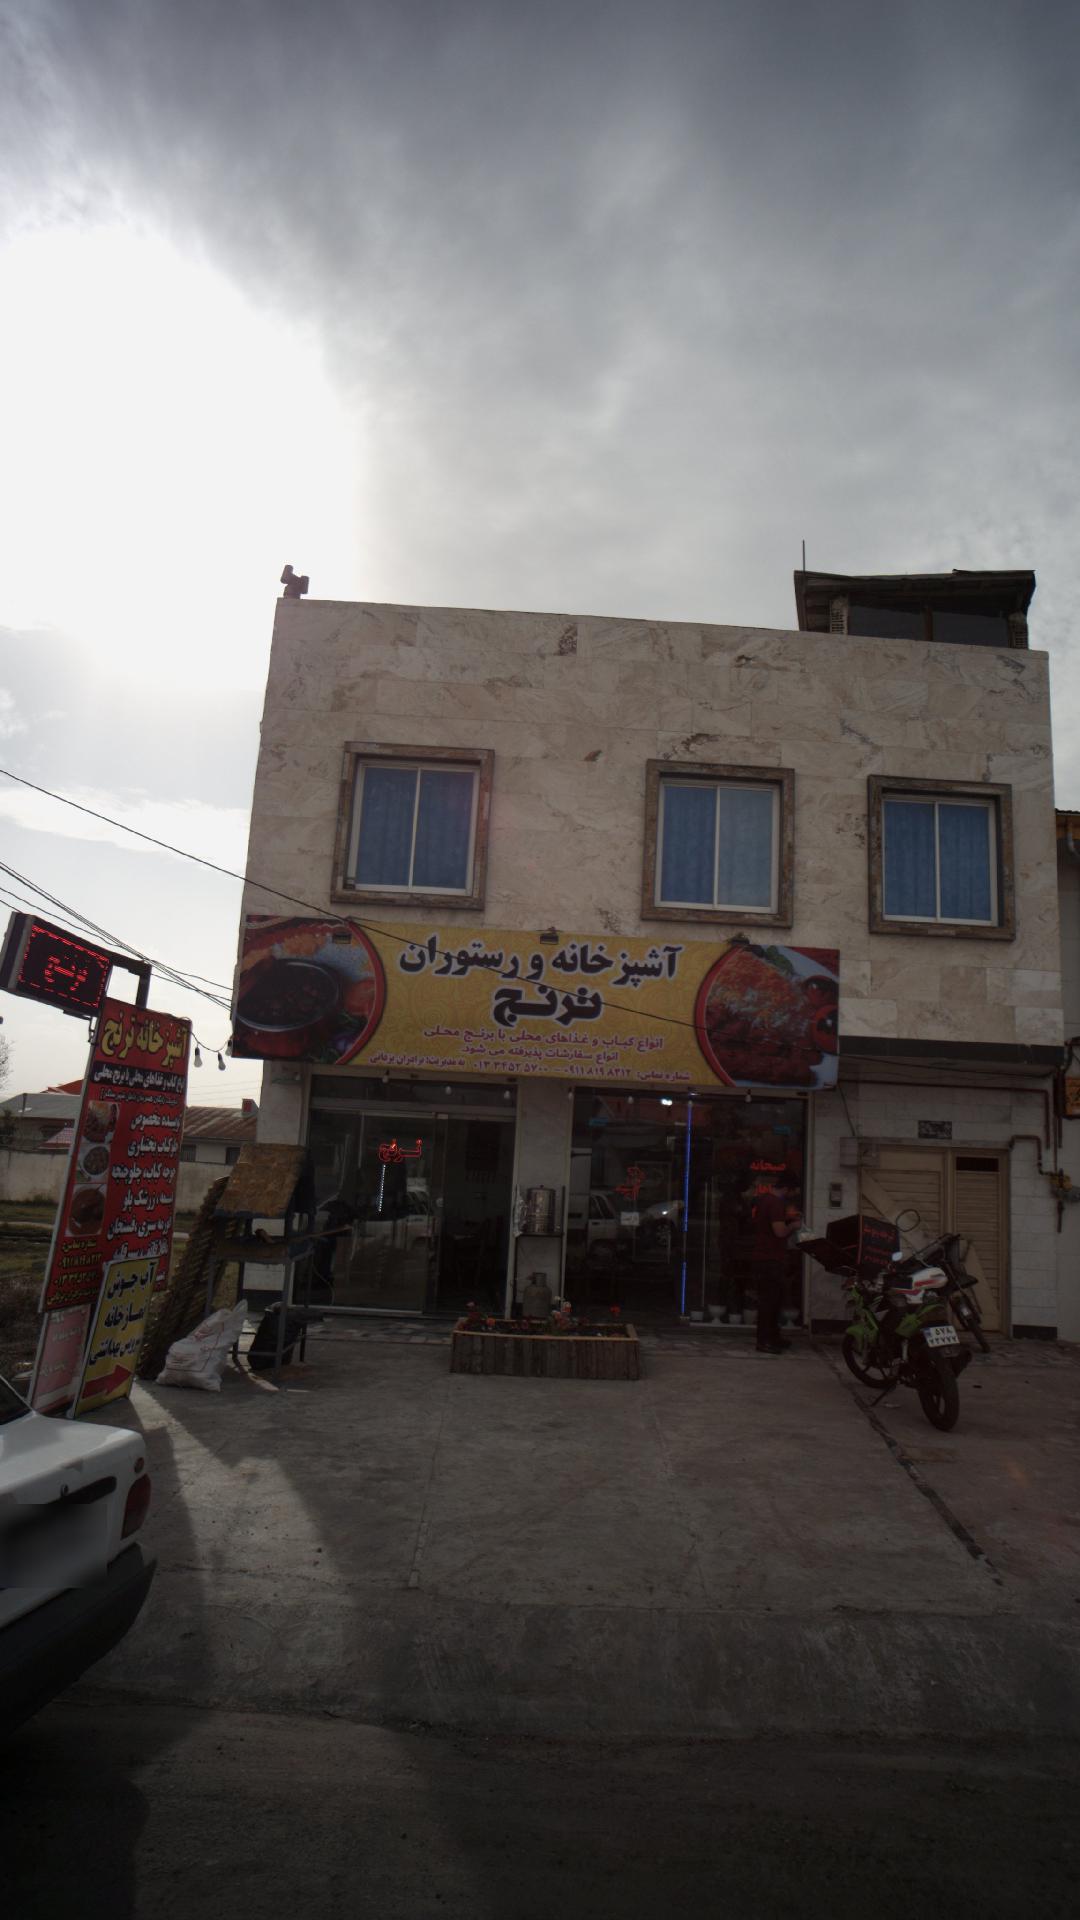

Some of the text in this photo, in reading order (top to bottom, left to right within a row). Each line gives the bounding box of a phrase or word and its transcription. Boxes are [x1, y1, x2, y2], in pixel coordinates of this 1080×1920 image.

[399, 934, 683, 988] آشپزخانه و رستوران
[492, 984, 604, 1028] ترنج
[101, 1010, 135, 1060] ترنج
[423, 1024, 460, 1038] محلی
[463, 1027, 495, 1043] برنج
[498, 1028, 506, 1041] با
[509, 1029, 542, 1043] محلی
[545, 1032, 589, 1045] غذاهای
[602, 1035, 634, 1049] کباب
[637, 1036, 664, 1052] انواع
[461, 1043, 619, 1065] انواع سفارشات پذیرفته می شود
